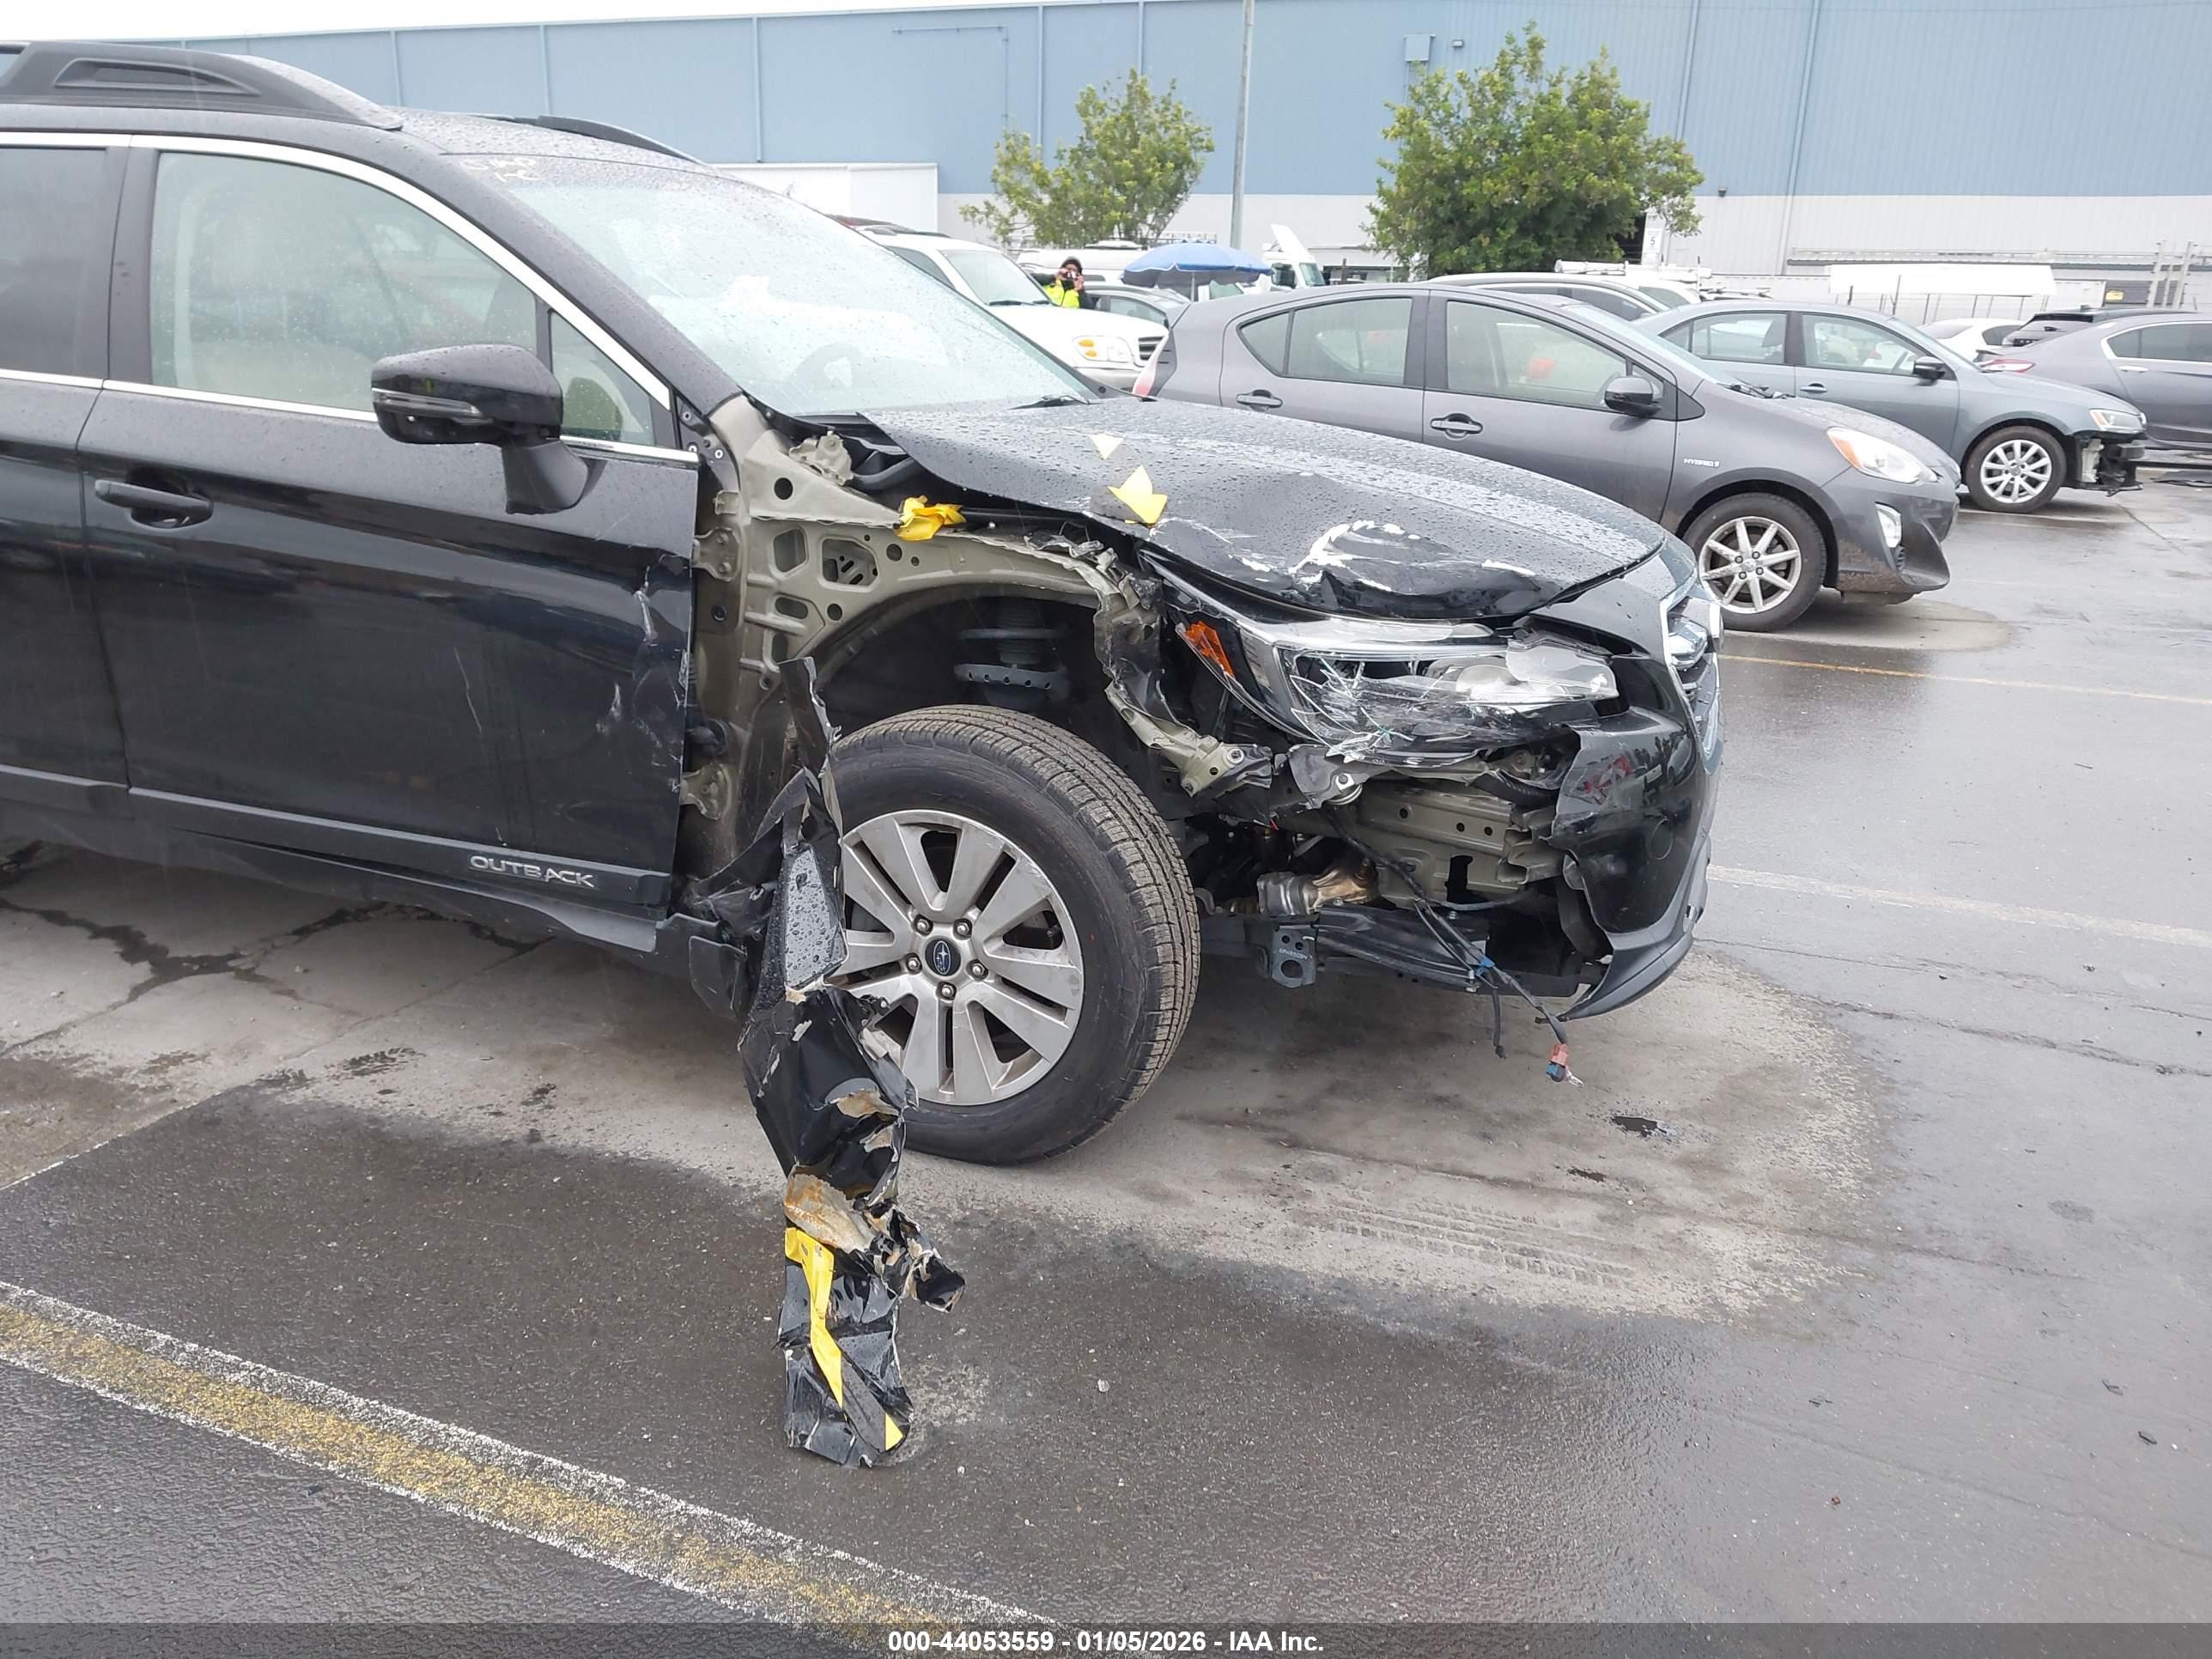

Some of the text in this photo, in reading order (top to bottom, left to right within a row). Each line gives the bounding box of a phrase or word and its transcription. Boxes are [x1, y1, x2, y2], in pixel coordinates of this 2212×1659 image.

[1650, 236, 1656, 246] 5
[1683, 458, 1714, 467] HYBRID
[471, 855, 595, 888] OUTBACK
